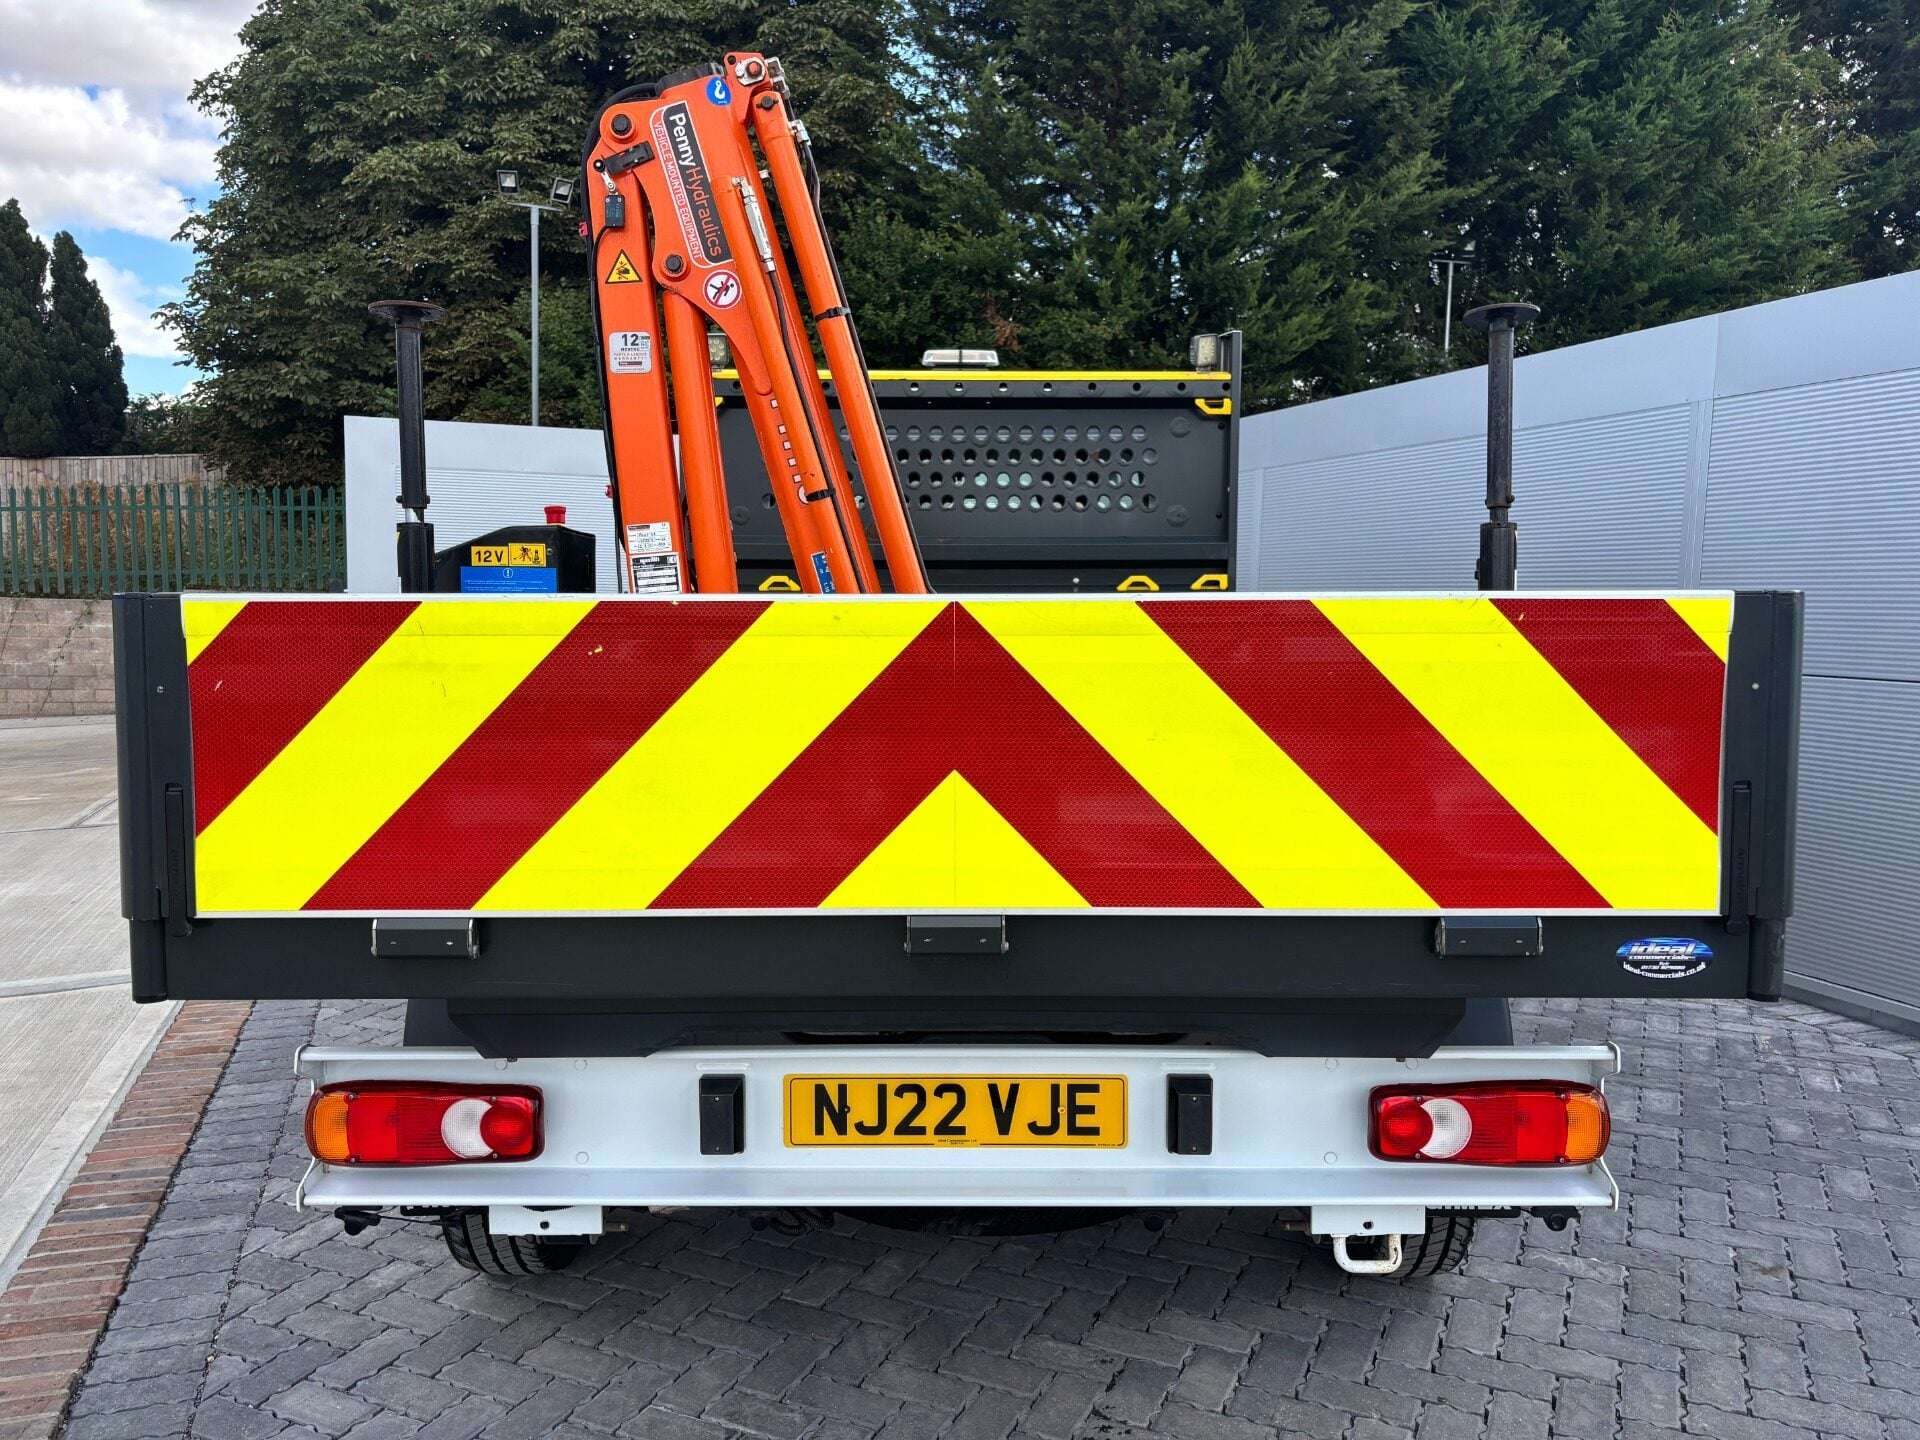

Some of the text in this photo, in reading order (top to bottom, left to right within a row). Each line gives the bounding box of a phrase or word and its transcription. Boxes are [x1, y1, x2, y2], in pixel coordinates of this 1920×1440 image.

[653, 121, 702, 260] VEHICLE MOUNTED EQUIPMENT
[669, 113, 722, 257] Penny Hydraulics
[621, 333, 639, 347] 12
[1629, 942, 1697, 956] ideal
[813, 1083, 1101, 1137] NJ22 VJE
